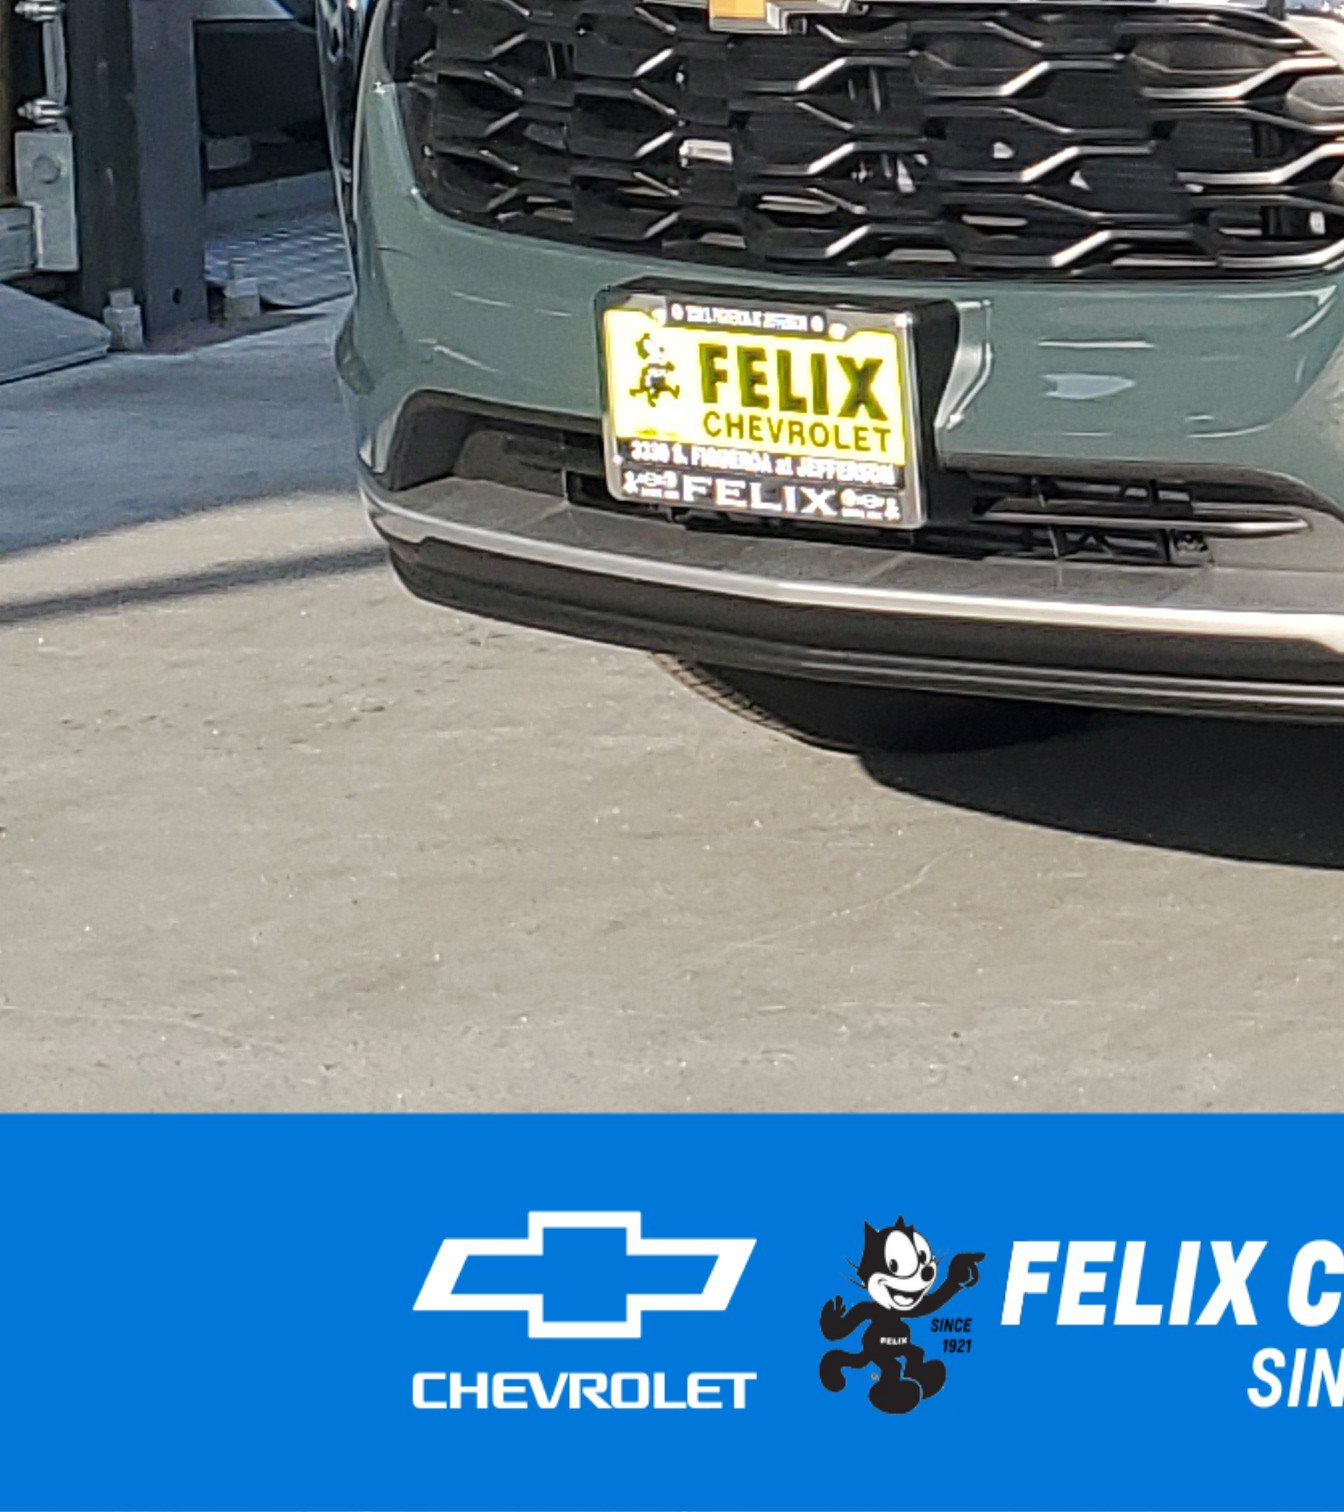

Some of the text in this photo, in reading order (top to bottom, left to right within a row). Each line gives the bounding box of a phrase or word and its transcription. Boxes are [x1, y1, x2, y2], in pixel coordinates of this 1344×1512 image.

[698, 342, 889, 422] FELIX
[702, 410, 892, 453] CHEVROLET
[682, 473, 838, 518] FELIX
